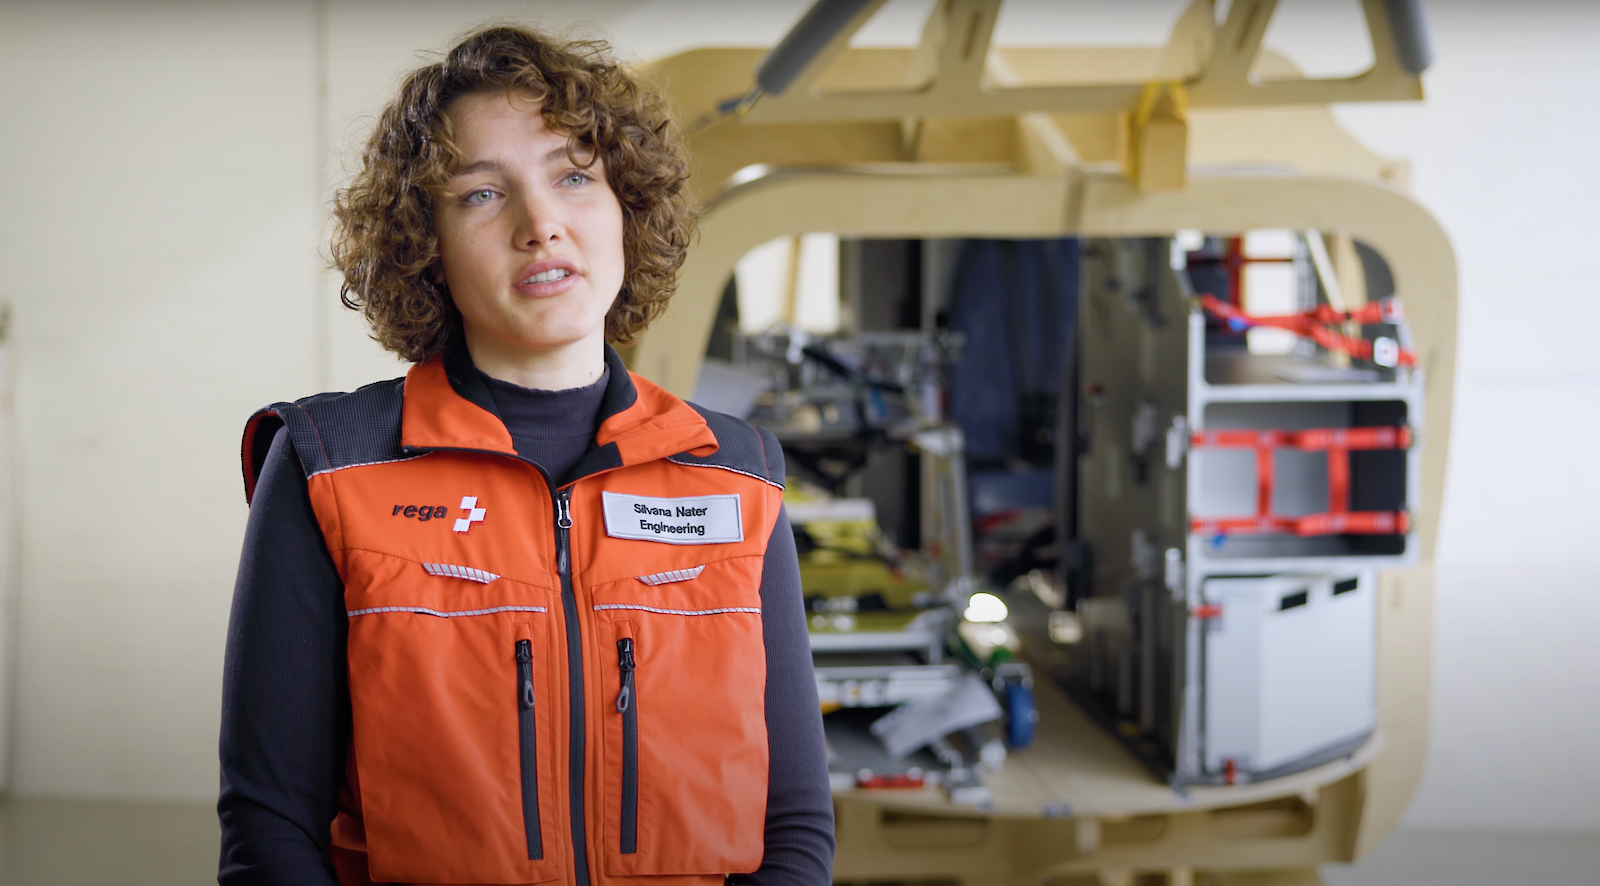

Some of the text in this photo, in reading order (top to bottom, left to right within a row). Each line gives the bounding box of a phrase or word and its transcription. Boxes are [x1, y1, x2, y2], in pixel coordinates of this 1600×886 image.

[392, 503, 448, 521] rega
[633, 503, 708, 518] Silvana Nater
[639, 519, 705, 536] Engineering
